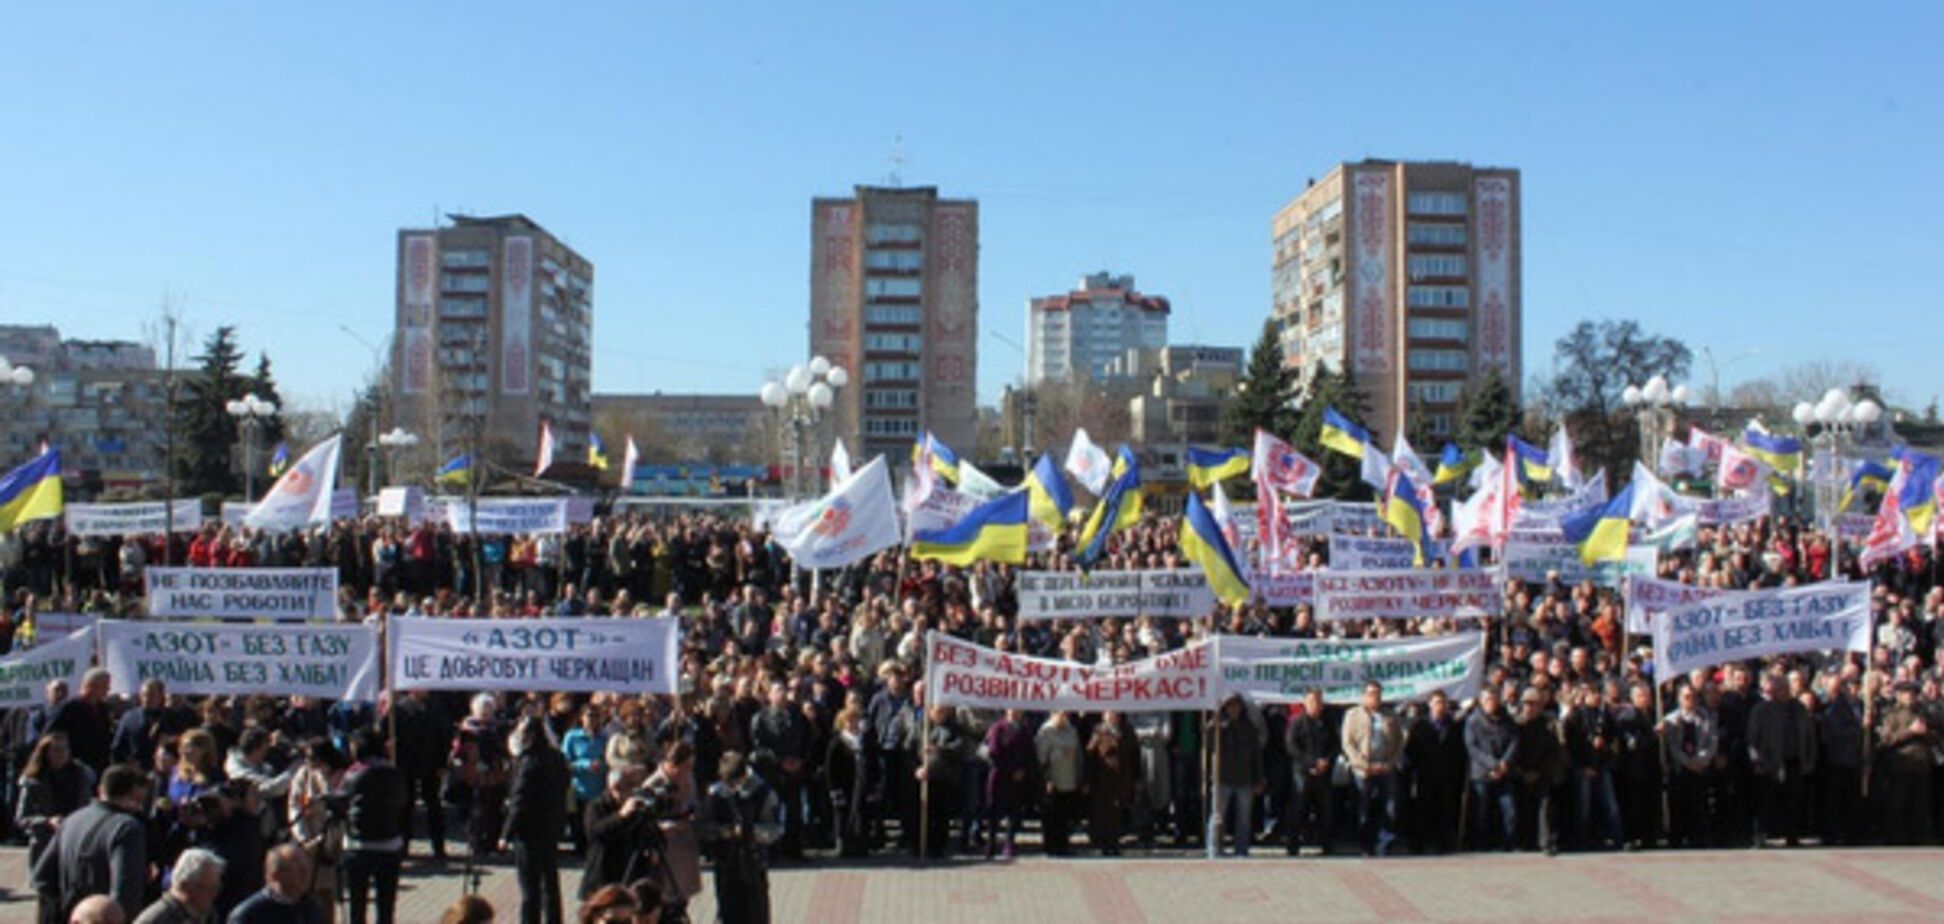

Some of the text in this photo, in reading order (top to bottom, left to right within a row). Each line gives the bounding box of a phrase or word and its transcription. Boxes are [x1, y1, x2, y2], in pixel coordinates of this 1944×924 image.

[170, 592, 212, 609] НАС
[1743, 598, 1785, 620] БЕЗ
[1792, 594, 1848, 616] ГАЗУ
[241, 633, 287, 657] БЕЗ
[296, 634, 352, 656] ГАЗУ
[1722, 624, 1763, 648] БЕЗ
[933, 641, 978, 669] БЕЗ
[136, 655, 215, 683] КРАЇНА
[222, 661, 267, 684] БЕЗ
[403, 654, 655, 684] ЦЕ ДОБРОБУТ ЧЕРКАЩАН
[942, 671, 1208, 702] РОЗВИТКУ ЧЕРКАС!
